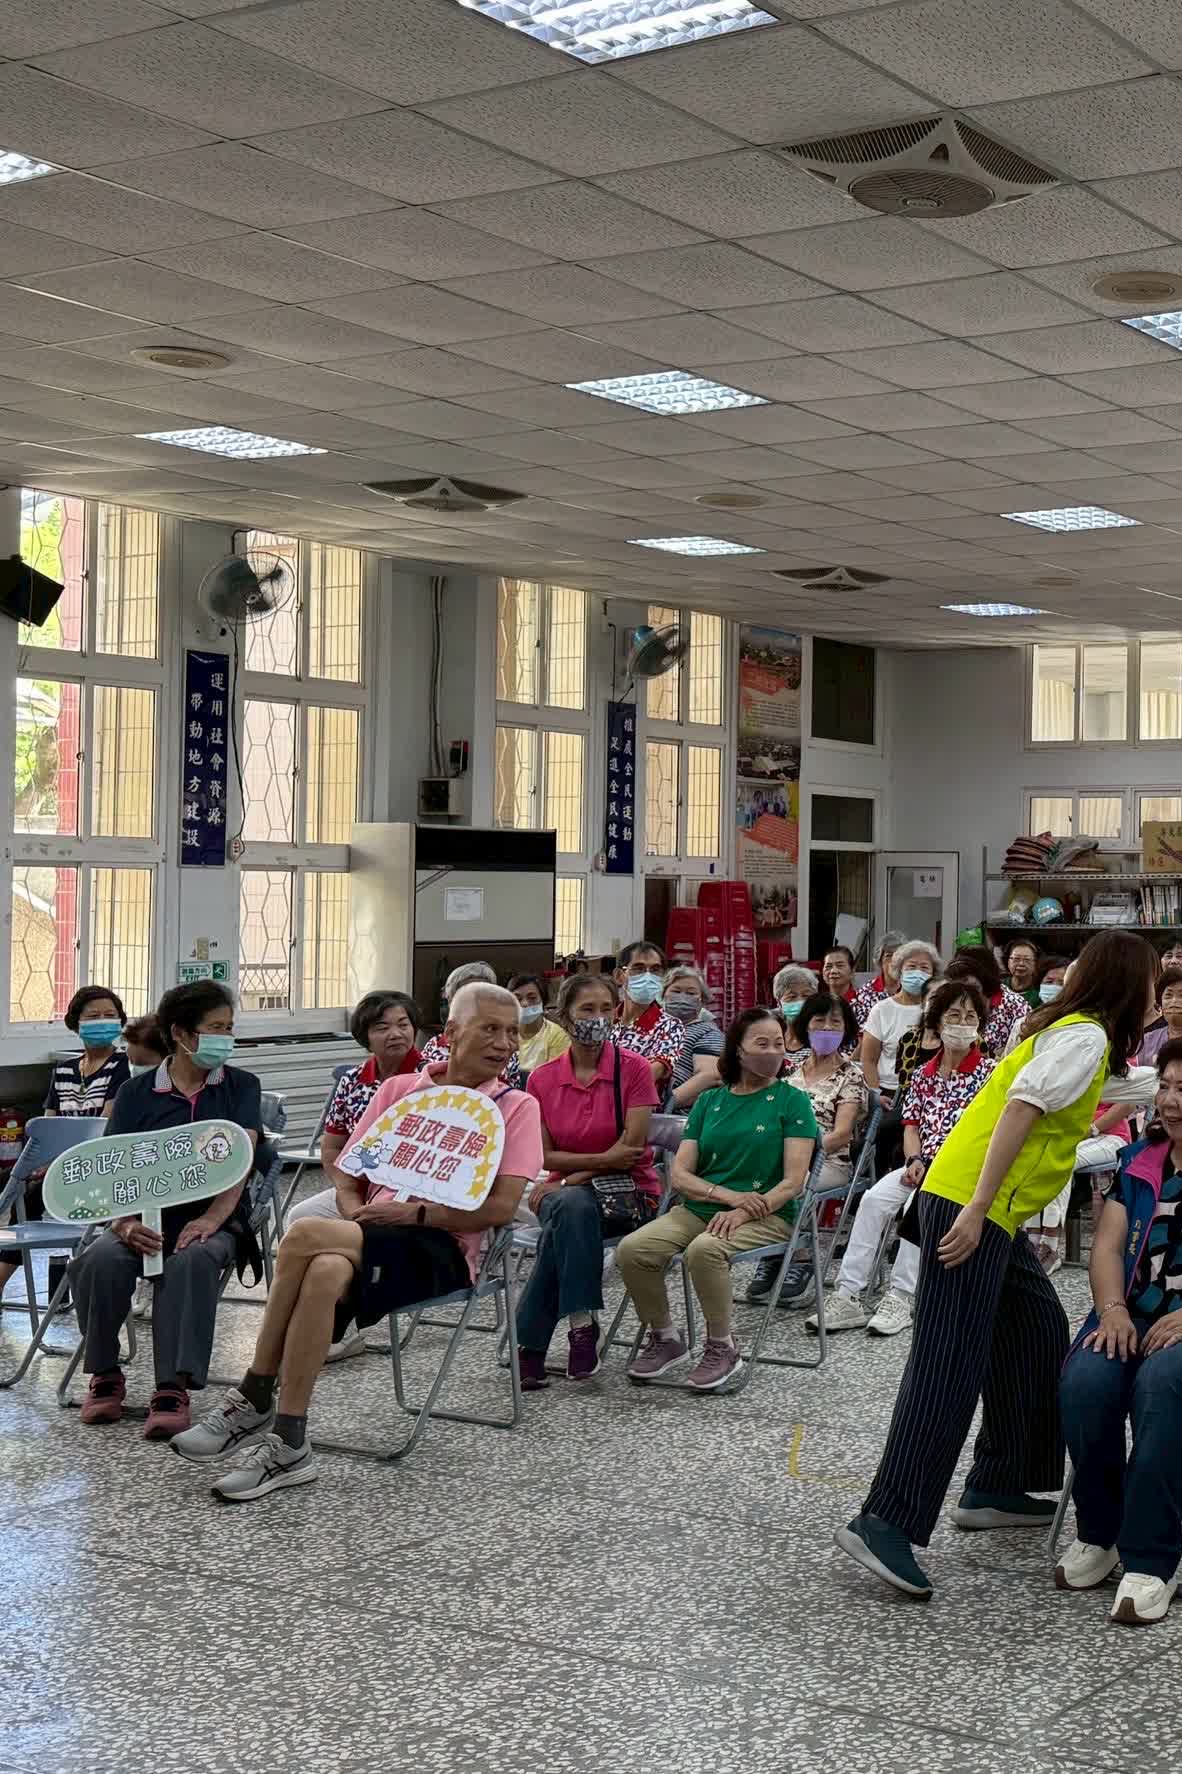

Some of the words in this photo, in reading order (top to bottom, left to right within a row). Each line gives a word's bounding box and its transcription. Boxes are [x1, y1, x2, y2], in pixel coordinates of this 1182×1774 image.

[184, 693, 203, 847] 帶動地方建設
[207, 672, 226, 825] 運用社會資源
[62, 1132, 193, 1185] 郵政壽險
[394, 1113, 488, 1159] 郵政壽險
[112, 1163, 207, 1205] 關心您
[388, 1141, 462, 1182] 關心您
